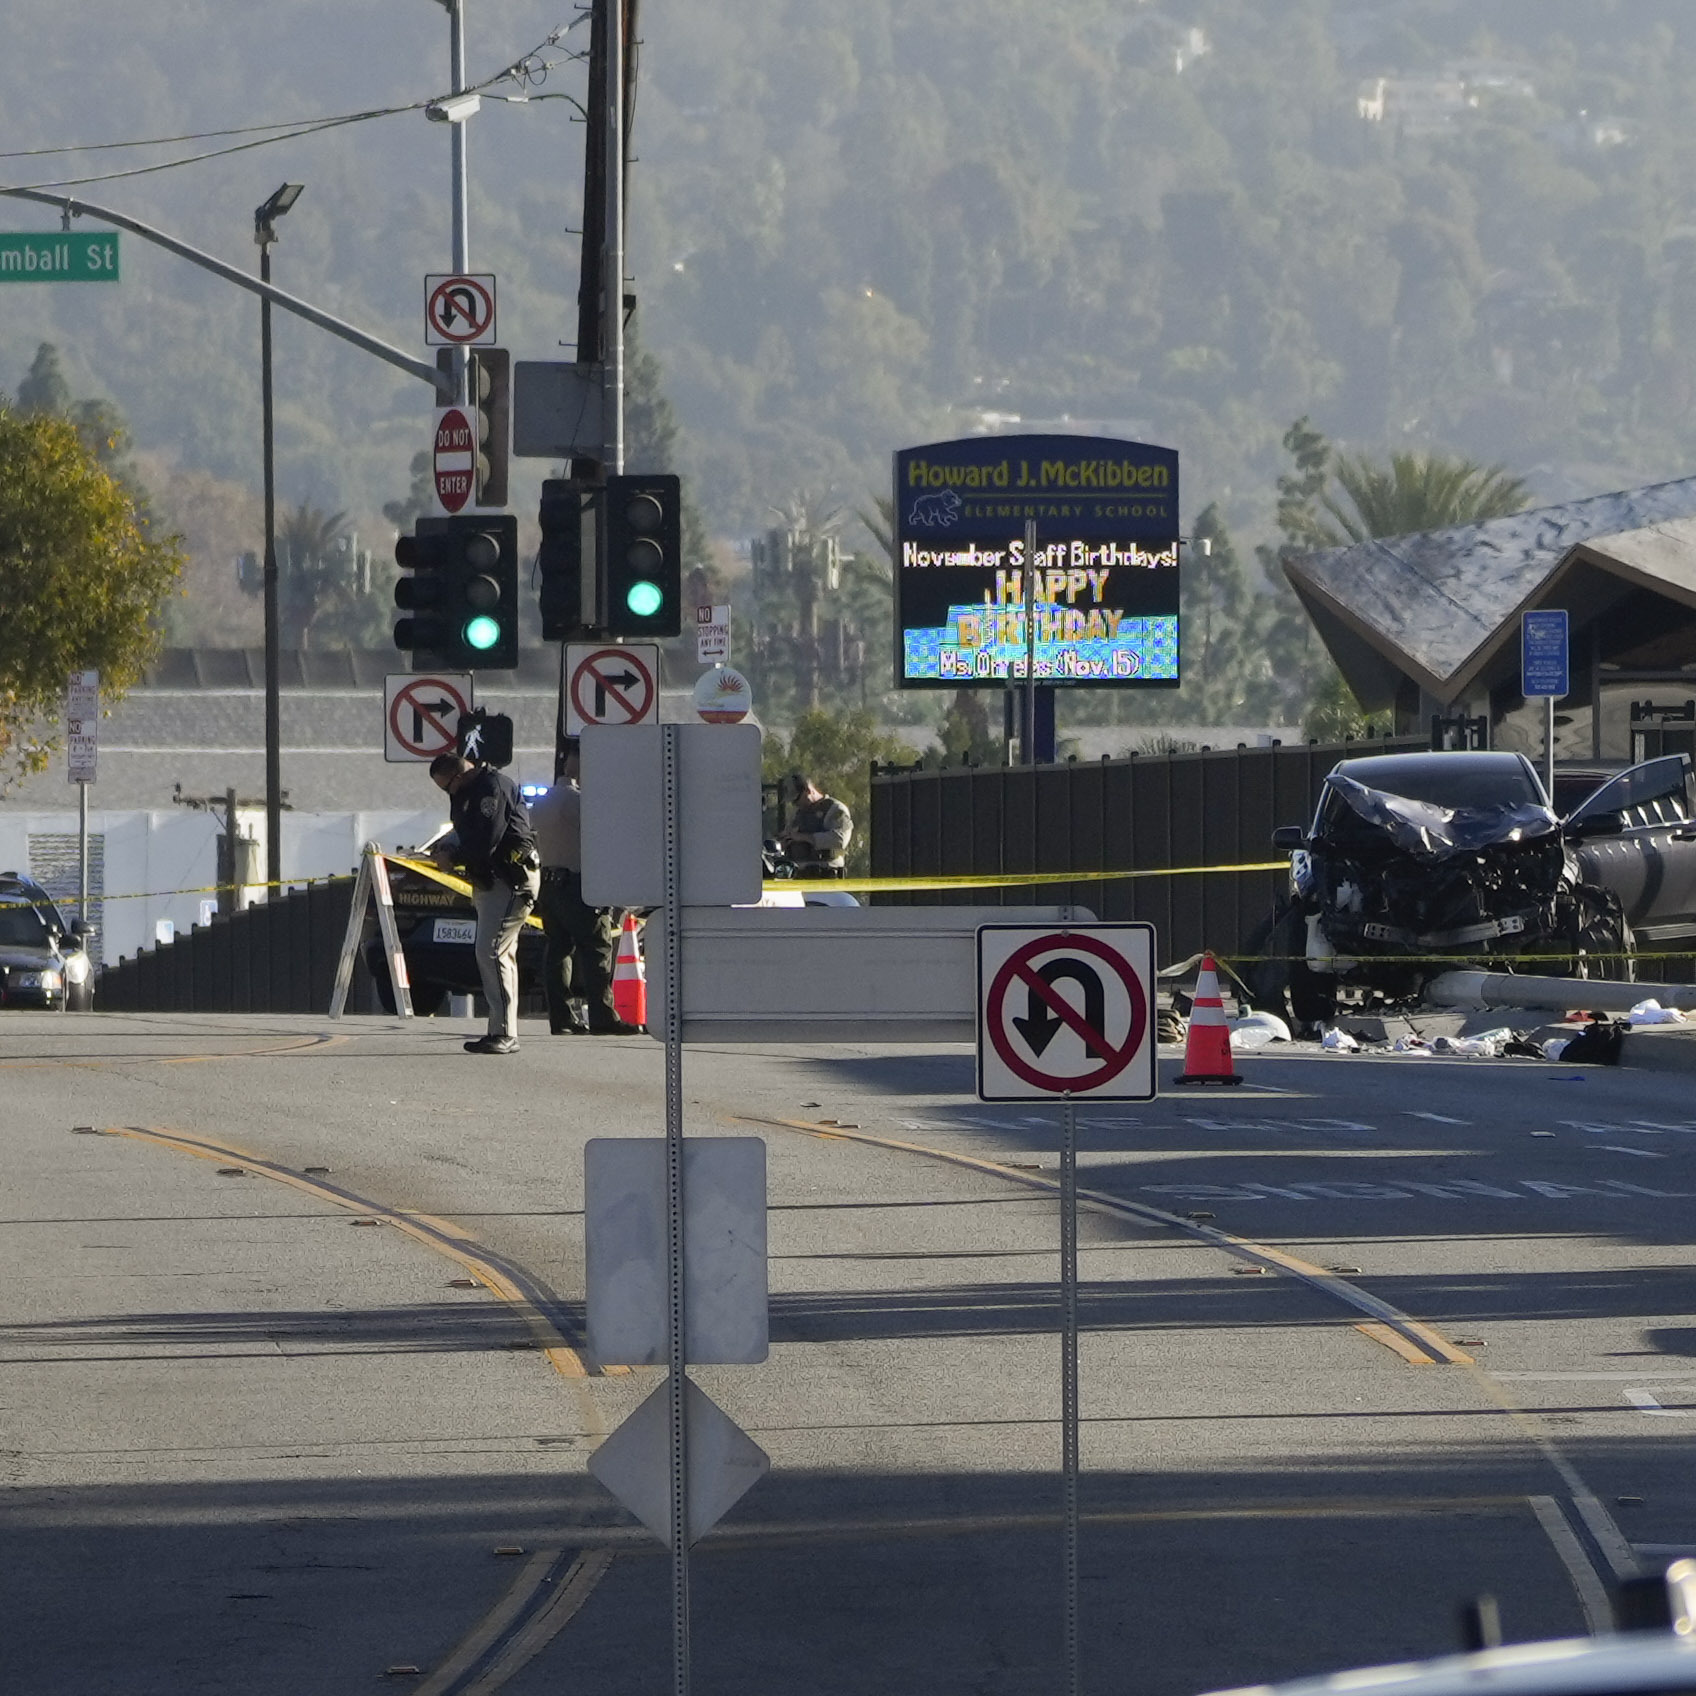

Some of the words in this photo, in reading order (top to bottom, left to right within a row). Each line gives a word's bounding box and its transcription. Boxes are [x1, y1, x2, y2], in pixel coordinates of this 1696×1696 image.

[87, 244, 114, 270] St
[438, 430, 450, 447] DO
[453, 428, 469, 446] NOT
[908, 460, 1009, 487] Howard
[1016, 460, 1037, 487] J.
[1041, 460, 1169, 487] McKibben
[440, 476, 467, 495] ENTER
[965, 505, 1083, 518] ELEMENTARY
[1095, 505, 1168, 518] SCHOOL
[903, 541, 1005, 568] November
[1009, 540, 1066, 568] Saff
[1070, 540, 1178, 569] Birthdays!
[996, 568, 1109, 606] HAPPY
[699, 606, 711, 622] NO
[698, 624, 729, 637] STOPPING
[400, 892, 456, 907] HIGHWAY
